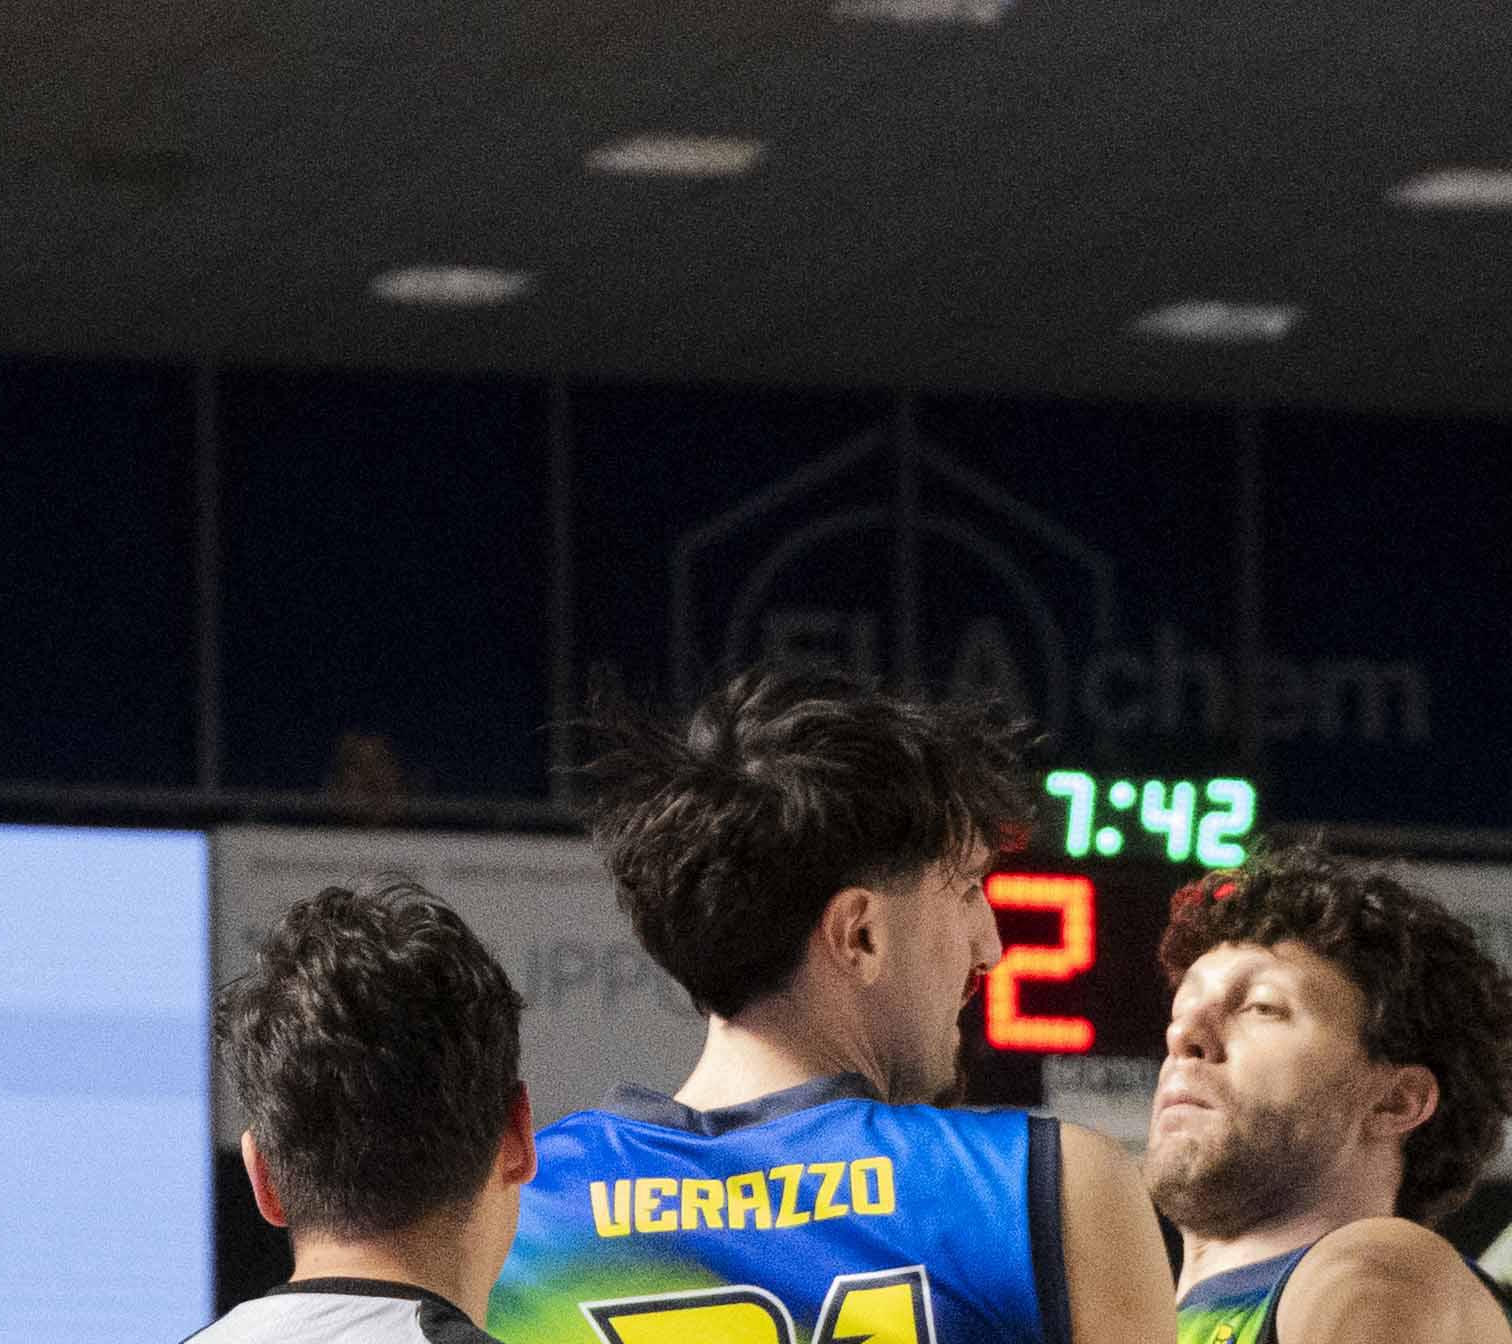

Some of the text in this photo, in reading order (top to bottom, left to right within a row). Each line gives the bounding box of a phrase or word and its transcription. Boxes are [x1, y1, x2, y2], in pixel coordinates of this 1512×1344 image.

[1045, 770, 1257, 868] 7:42
[984, 870, 1096, 1053] 2
[588, 1155, 895, 1239] VERAZZO
